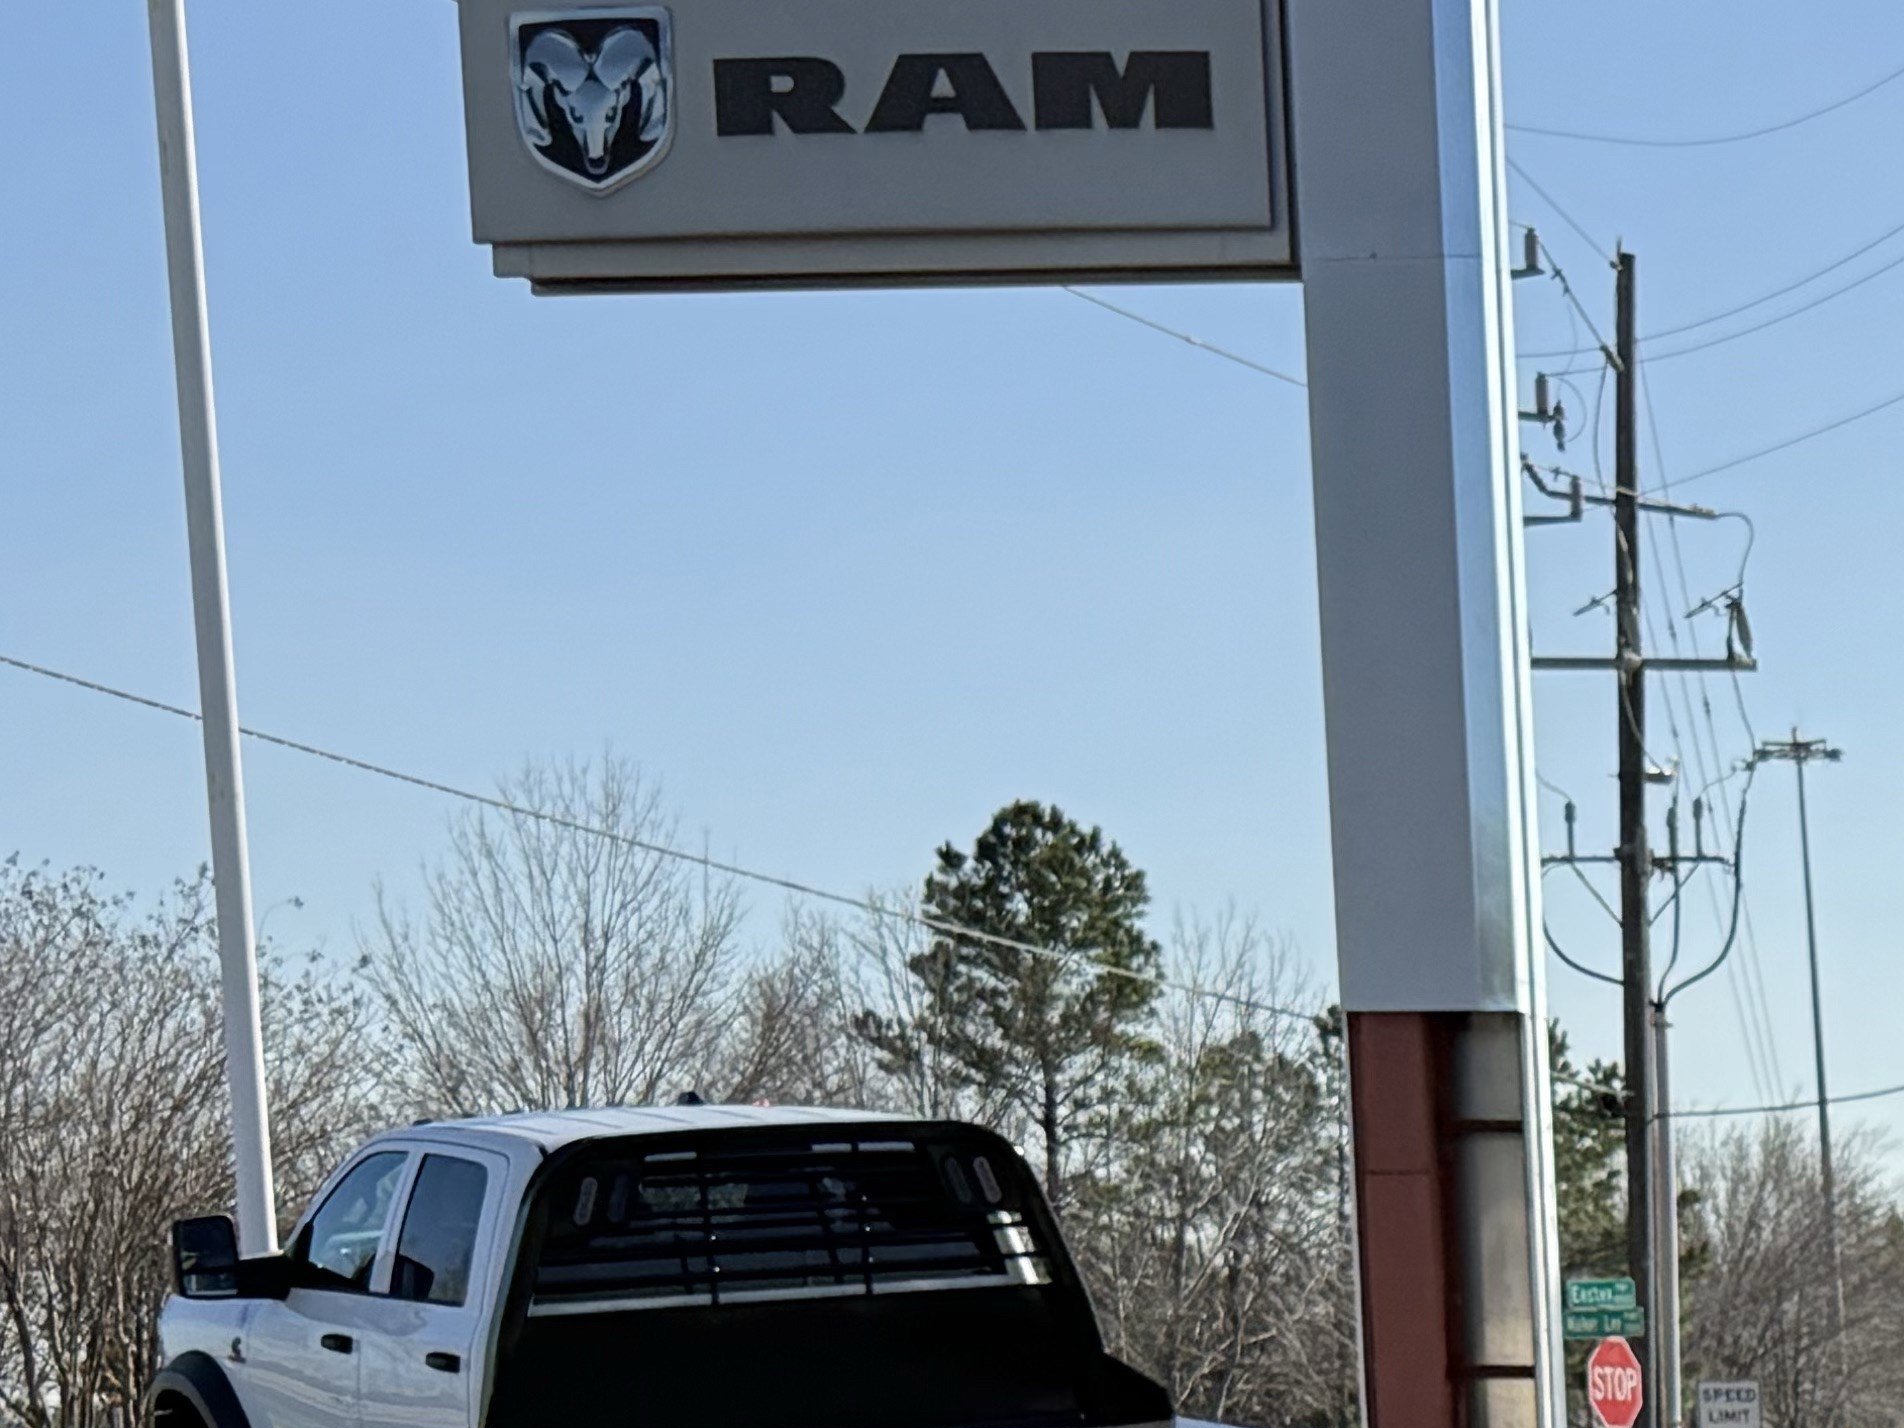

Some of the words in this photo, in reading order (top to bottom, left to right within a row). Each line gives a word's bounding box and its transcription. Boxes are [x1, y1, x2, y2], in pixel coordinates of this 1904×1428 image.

[714, 51, 1214, 137] RAM
[1593, 1365, 1638, 1402] STOP
[1702, 1387, 1757, 1404] SPEED
[1708, 1409, 1751, 1424] LIMIT
